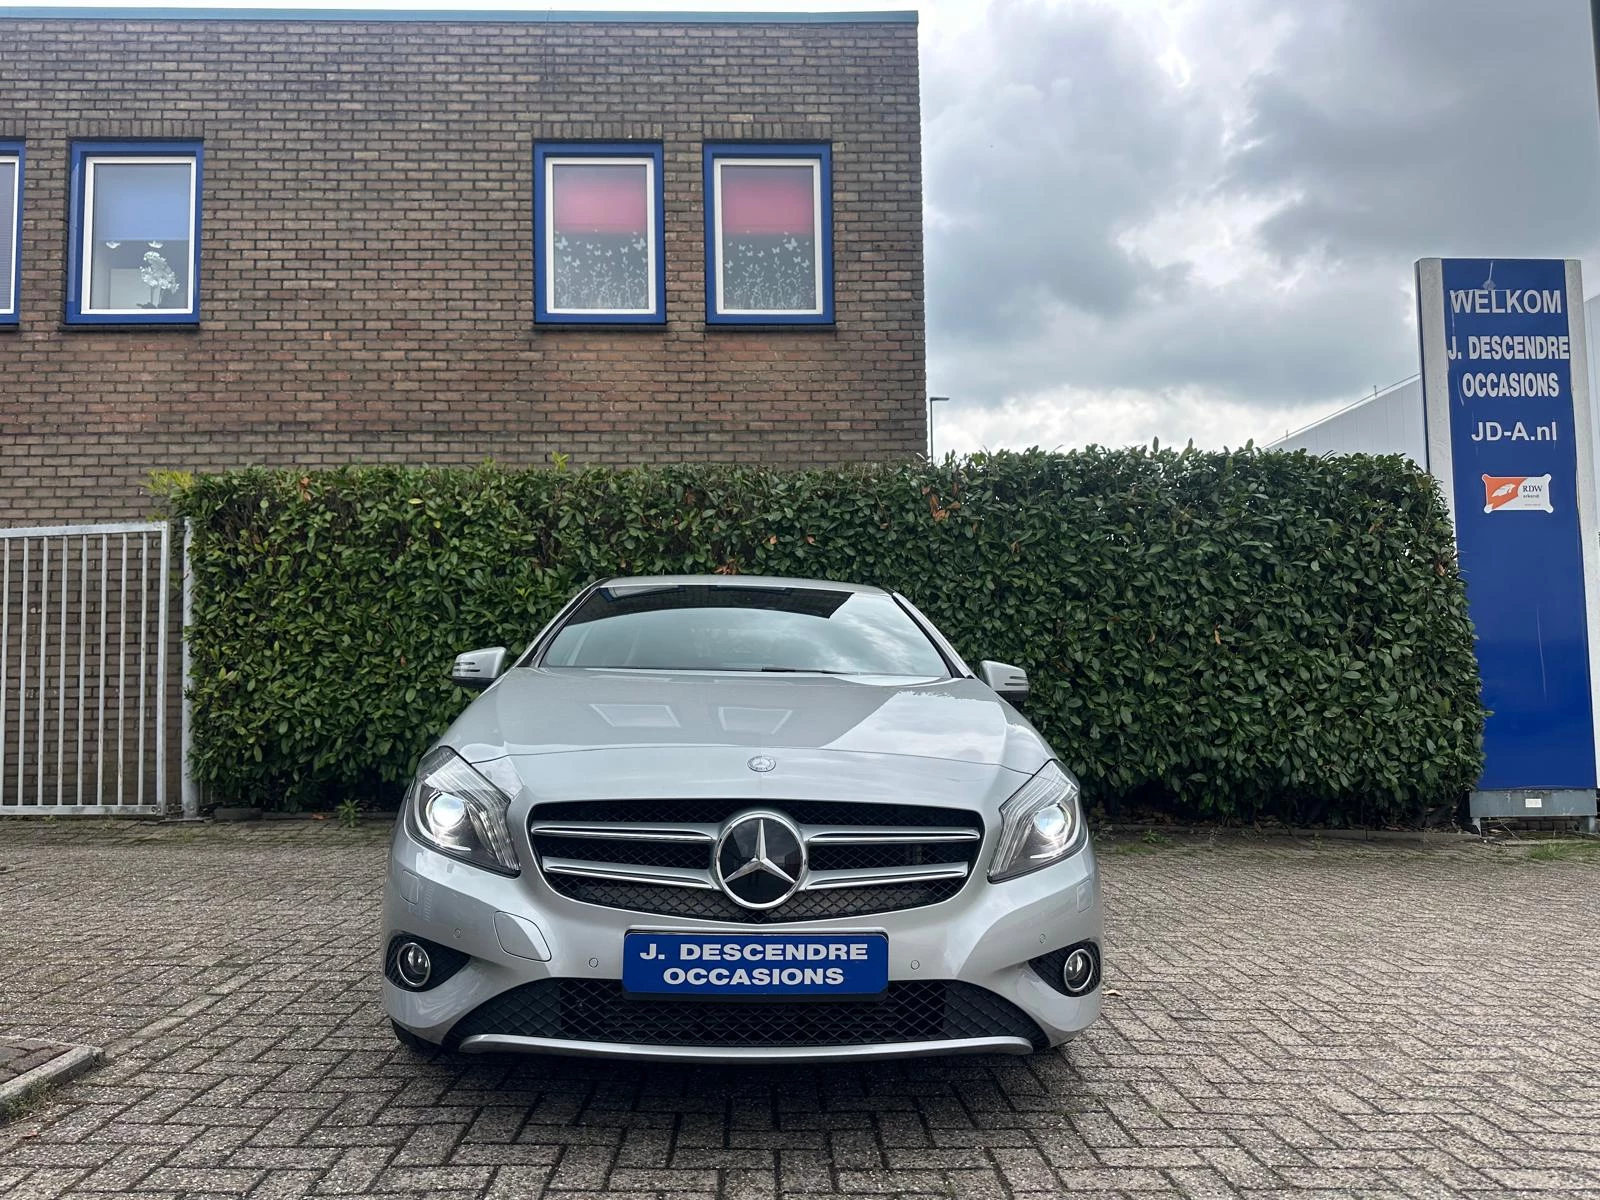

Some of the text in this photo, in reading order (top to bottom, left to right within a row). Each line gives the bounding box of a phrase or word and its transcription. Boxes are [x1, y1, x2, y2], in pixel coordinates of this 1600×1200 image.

[1450, 290, 1562, 314] WELKOM
[1448, 335, 1570, 360] J. DESCENDRE
[1462, 372, 1559, 397] OCCASIONS
[1471, 421, 1557, 441] JD-A.nl
[1522, 485, 1543, 493] RDW
[639, 943, 868, 961] J. DESCENDRE
[662, 967, 844, 986] OCCASIONS
